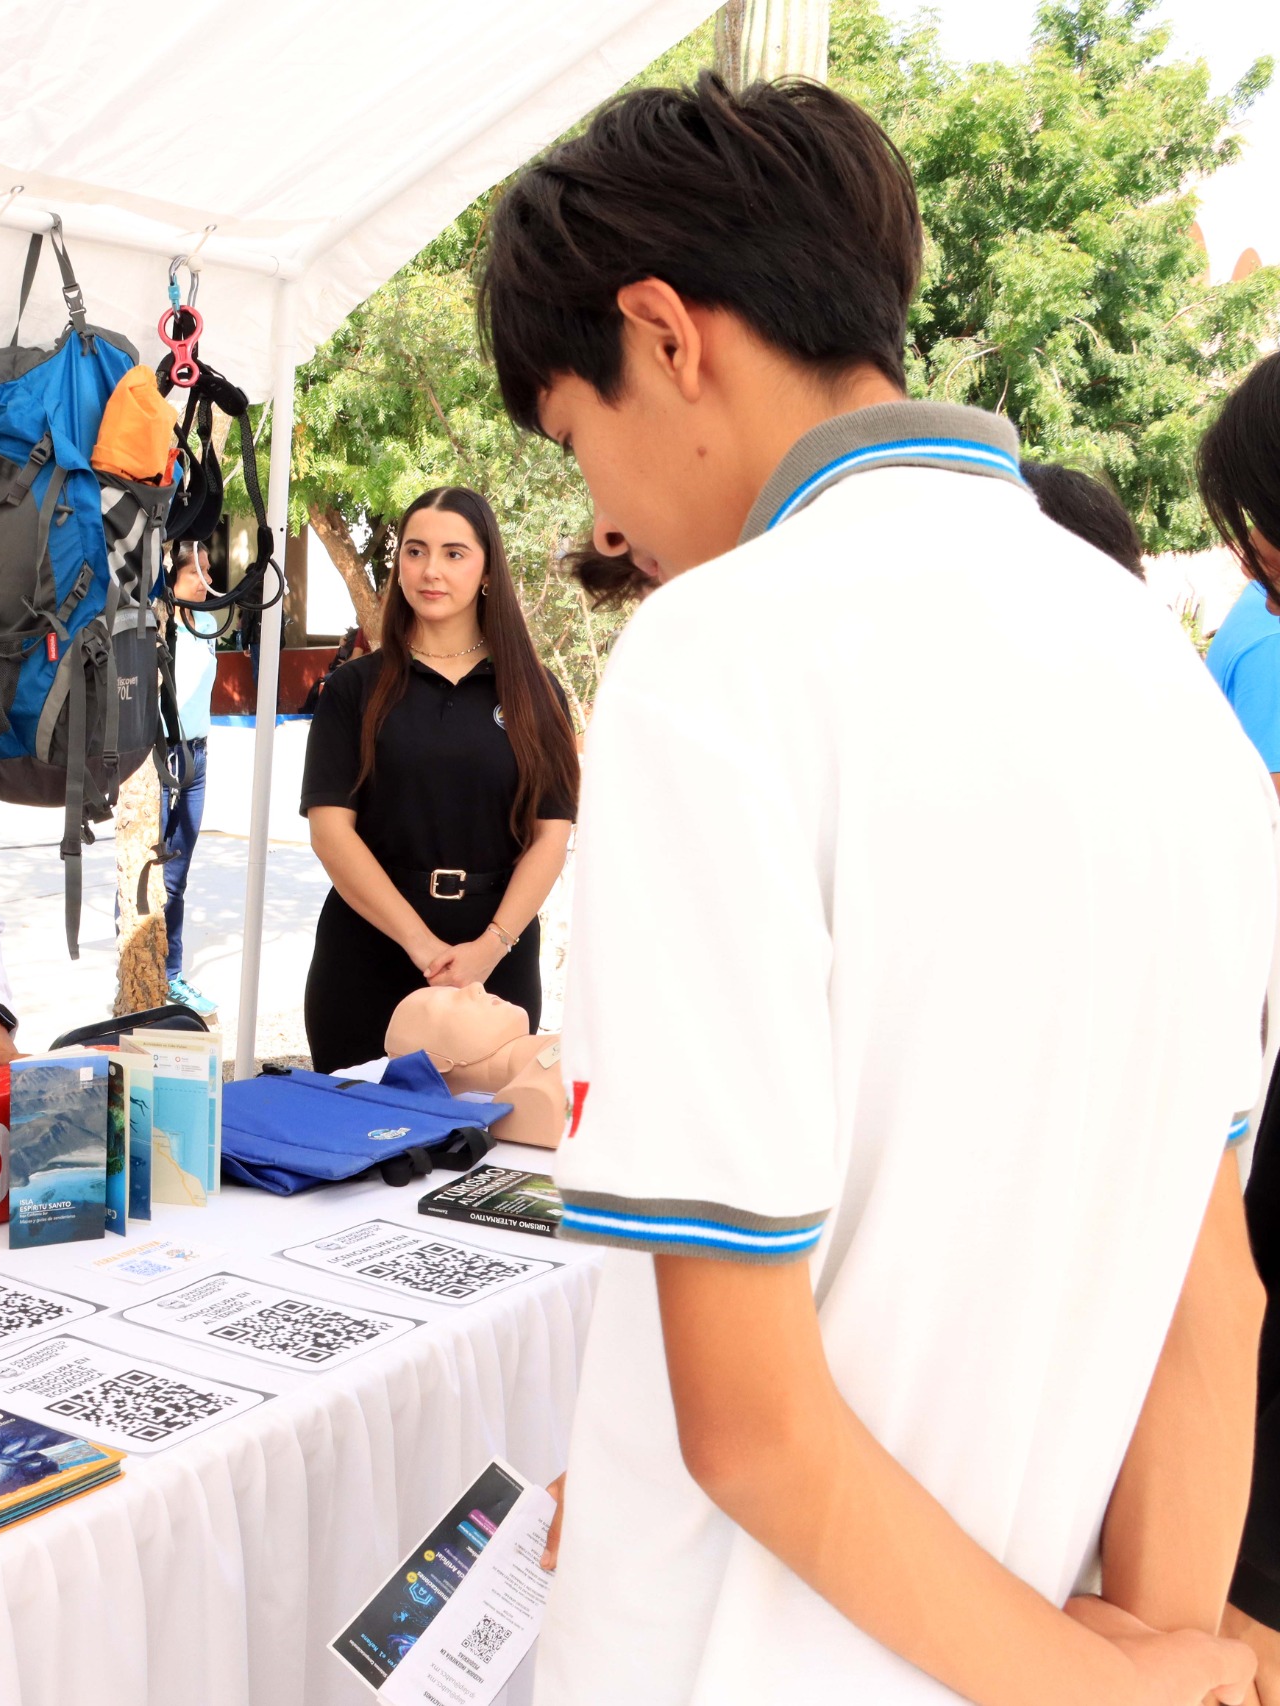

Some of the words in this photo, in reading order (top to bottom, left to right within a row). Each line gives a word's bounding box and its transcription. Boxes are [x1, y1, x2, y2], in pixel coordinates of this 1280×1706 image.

[433, 1168, 506, 1202] TURISMO
[458, 1171, 522, 1206] ALTERNATIVO
[48, 1201, 71, 1209] SANTO
[470, 1212, 517, 1227] ALTERNATIVO
[519, 1221, 550, 1232] TURISMO
[3, 1363, 74, 1394] LICENCIATURA
[74, 1357, 91, 1365] EN
